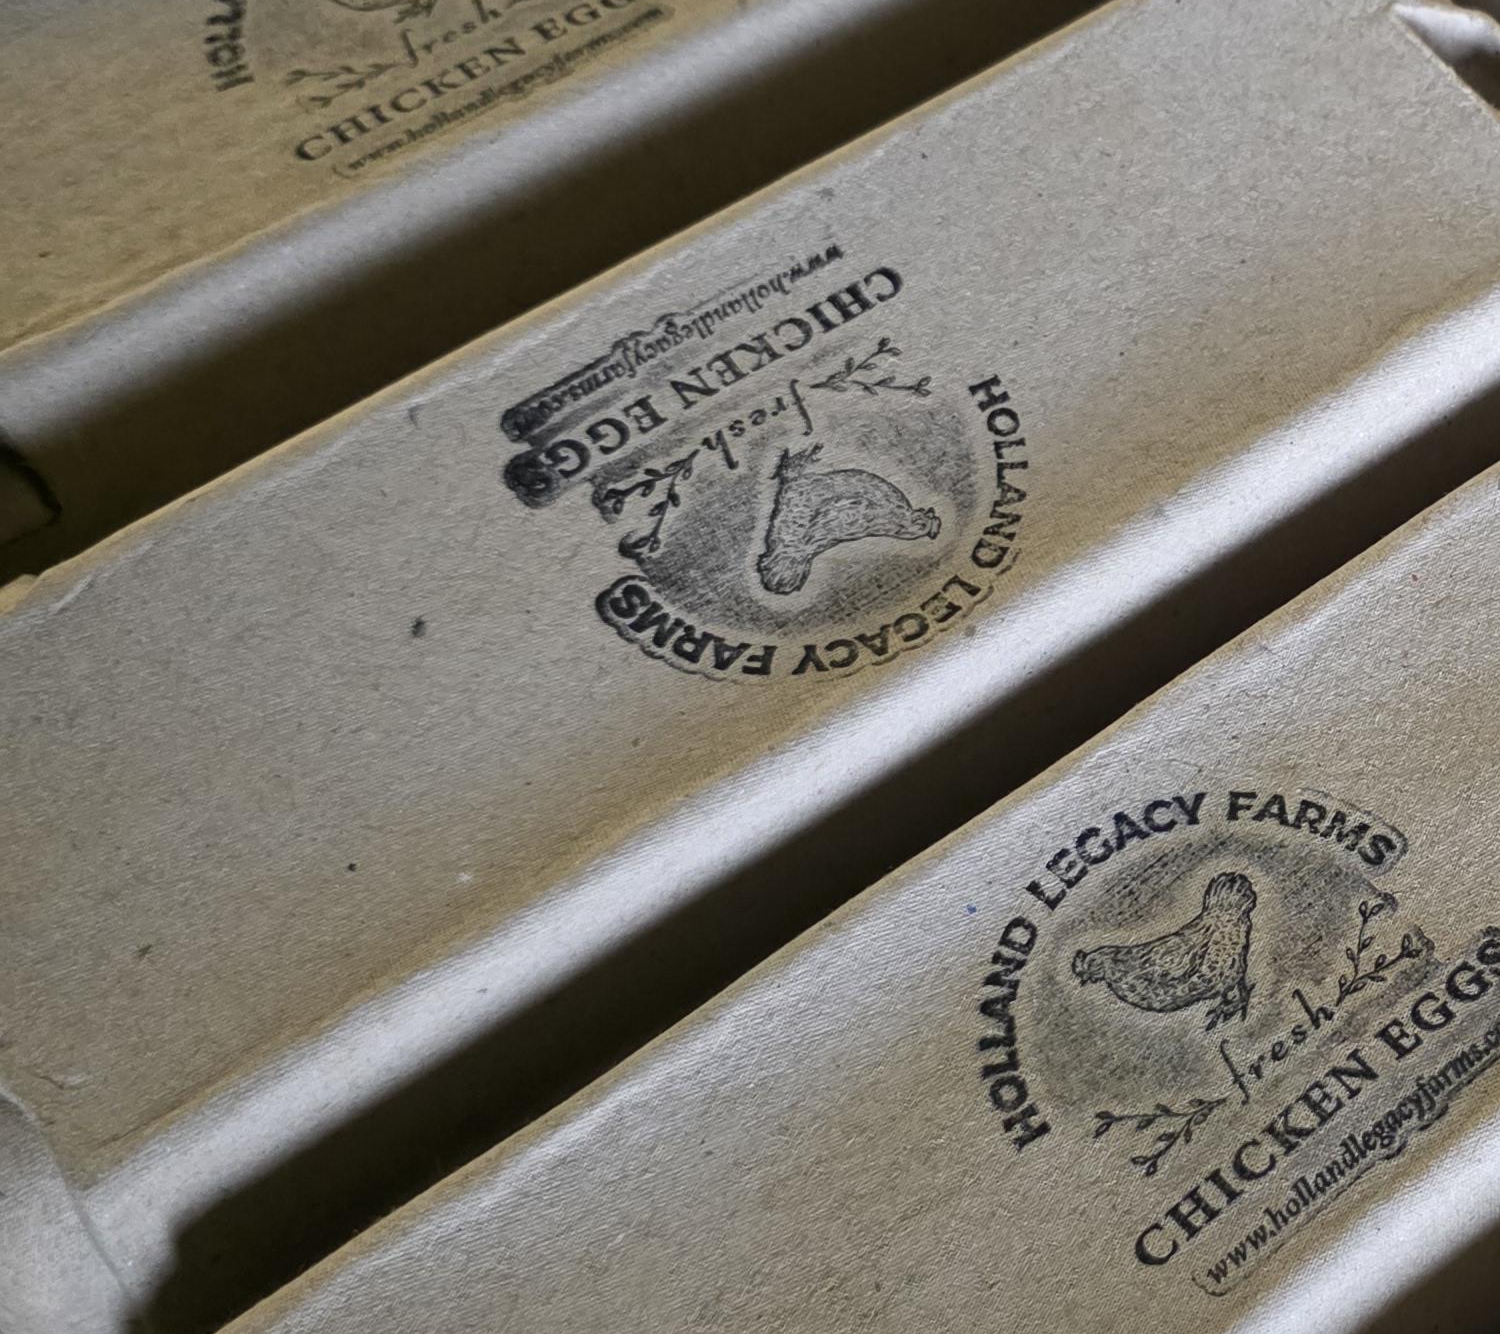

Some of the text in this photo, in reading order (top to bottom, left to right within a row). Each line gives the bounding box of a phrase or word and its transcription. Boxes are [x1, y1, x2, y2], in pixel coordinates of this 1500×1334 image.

[294, 36, 526, 162] CHICKEN
[668, 267, 902, 411] CHICKEN
[702, 378, 814, 470] fresh
[609, 373, 1029, 676] HOLLAND LEGACY FARMS
[978, 791, 1400, 1153] HOLLAND LEGACY FARMS
[1219, 987, 1336, 1105] fresh
[1133, 1049, 1381, 1268] CHICKEN
